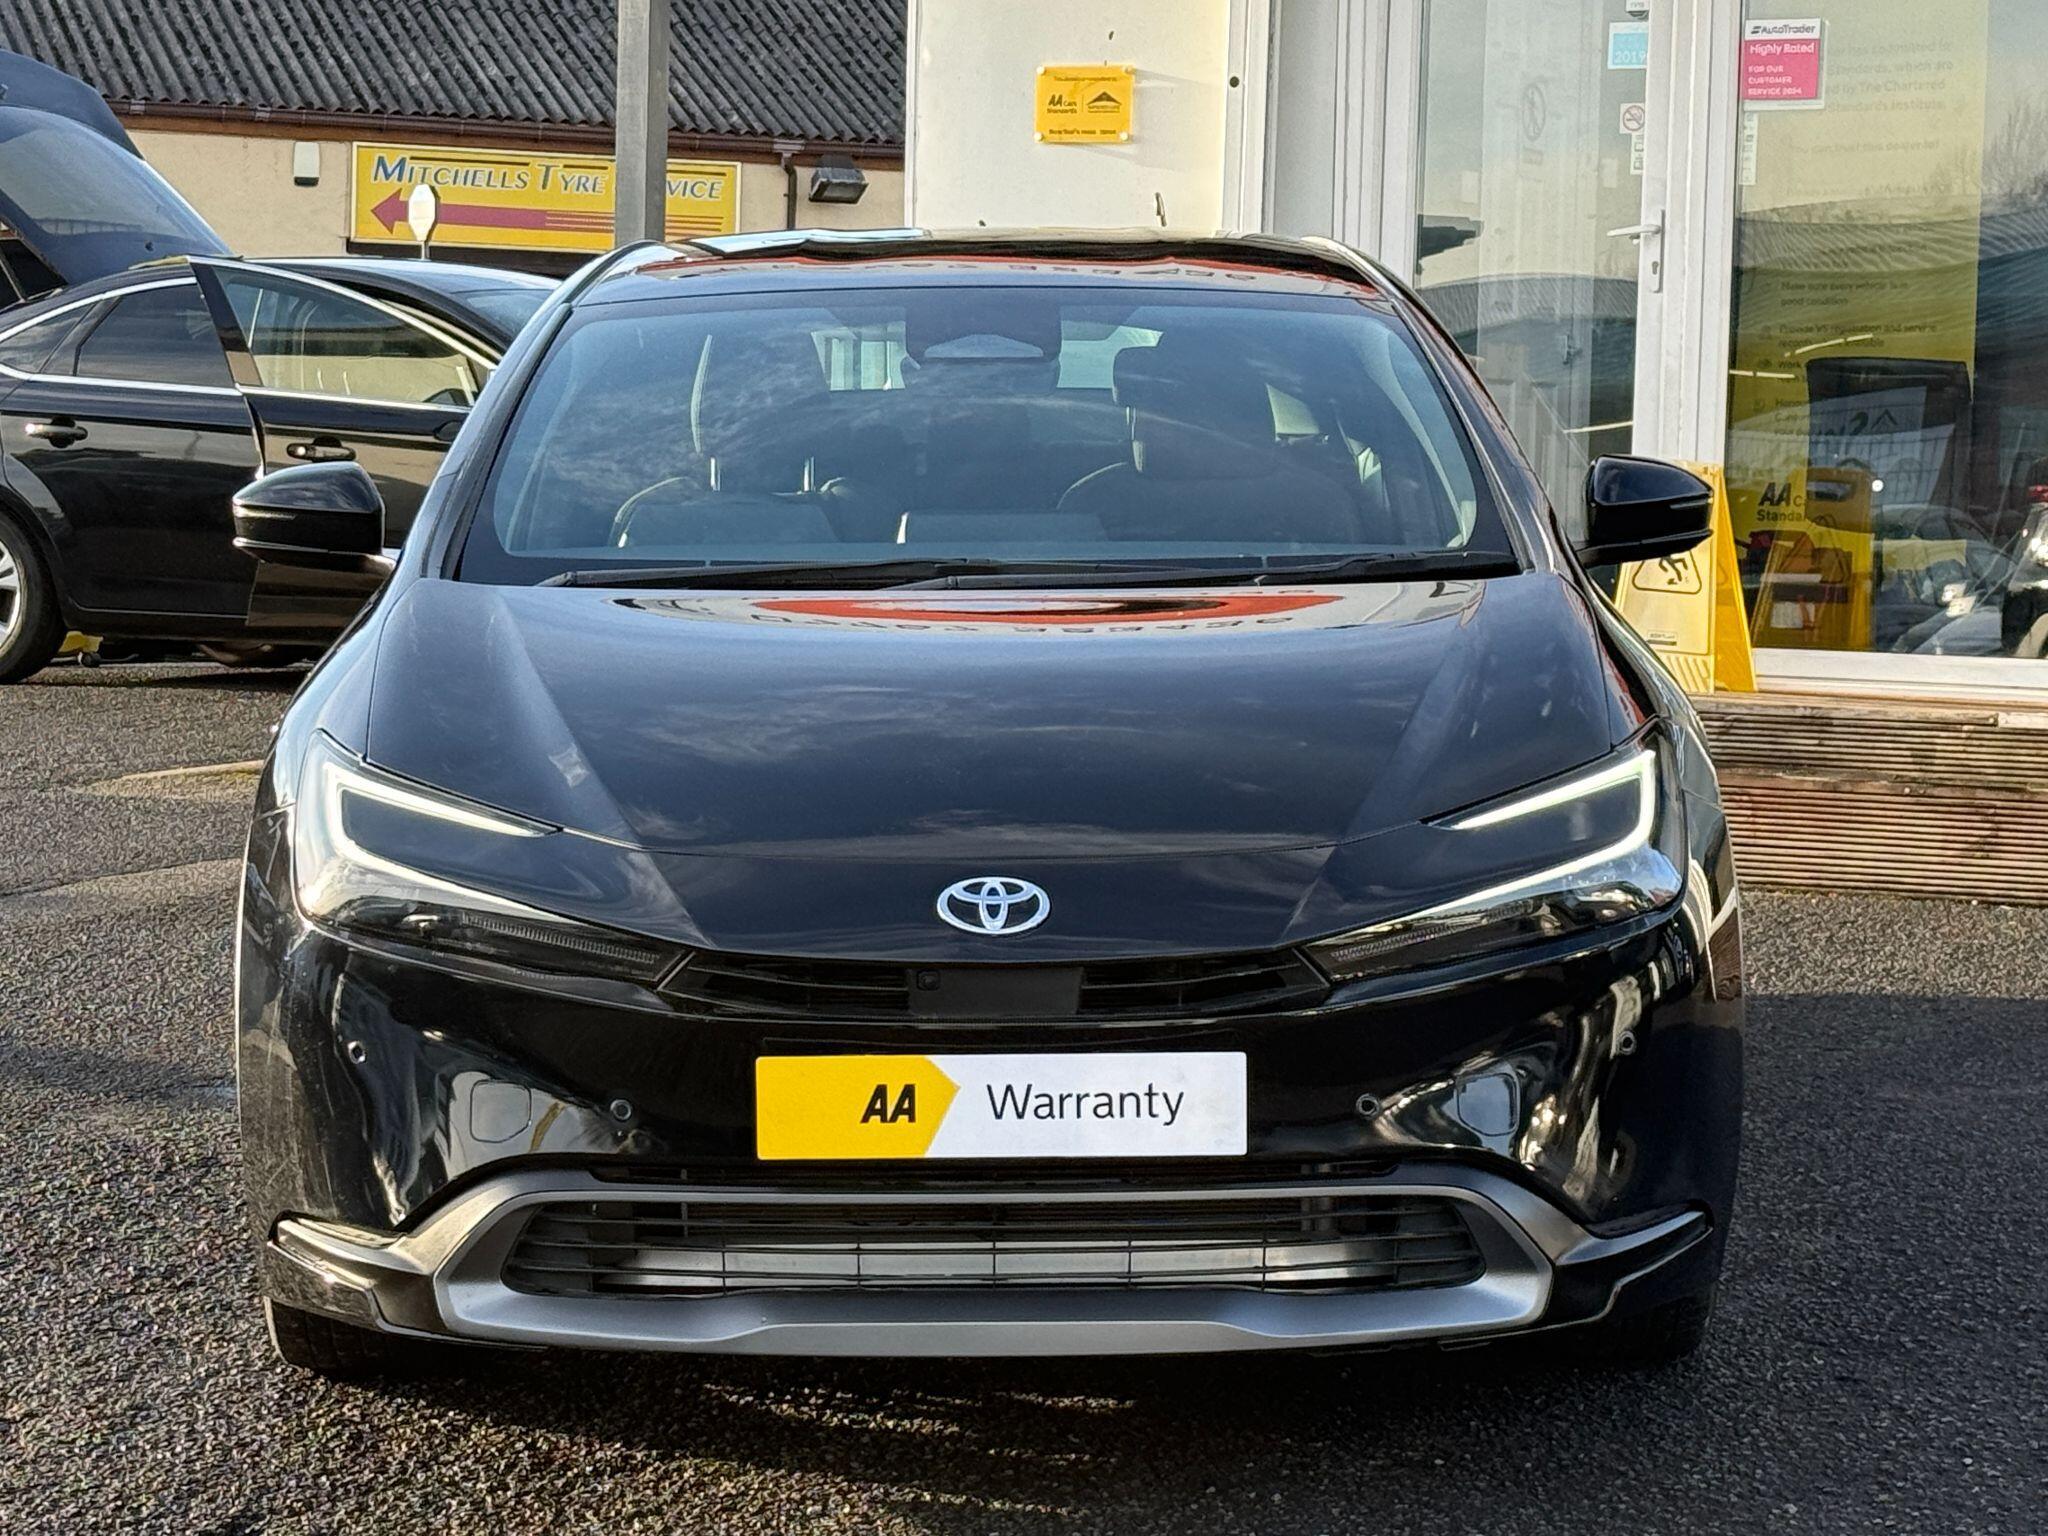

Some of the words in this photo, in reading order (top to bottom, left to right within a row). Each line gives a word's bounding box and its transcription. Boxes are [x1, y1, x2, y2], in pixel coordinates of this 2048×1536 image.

[1761, 24, 1816, 35] AutoTrader
[1750, 43, 1782, 56] Highly
[1783, 42, 1815, 54] Rated
[1748, 65, 1765, 73] FOR
[1766, 65, 1784, 73] OUR
[1748, 76, 1792, 84] CUSTOMER
[1748, 87, 1781, 95] SERVICE
[1048, 94, 1063, 107] AA
[537, 164, 606, 195] TYRE
[665, 176, 722, 200] VICE
[1758, 482, 1792, 507] AA
[859, 1083, 917, 1124] AA
[986, 1081, 1185, 1127] Warranty
